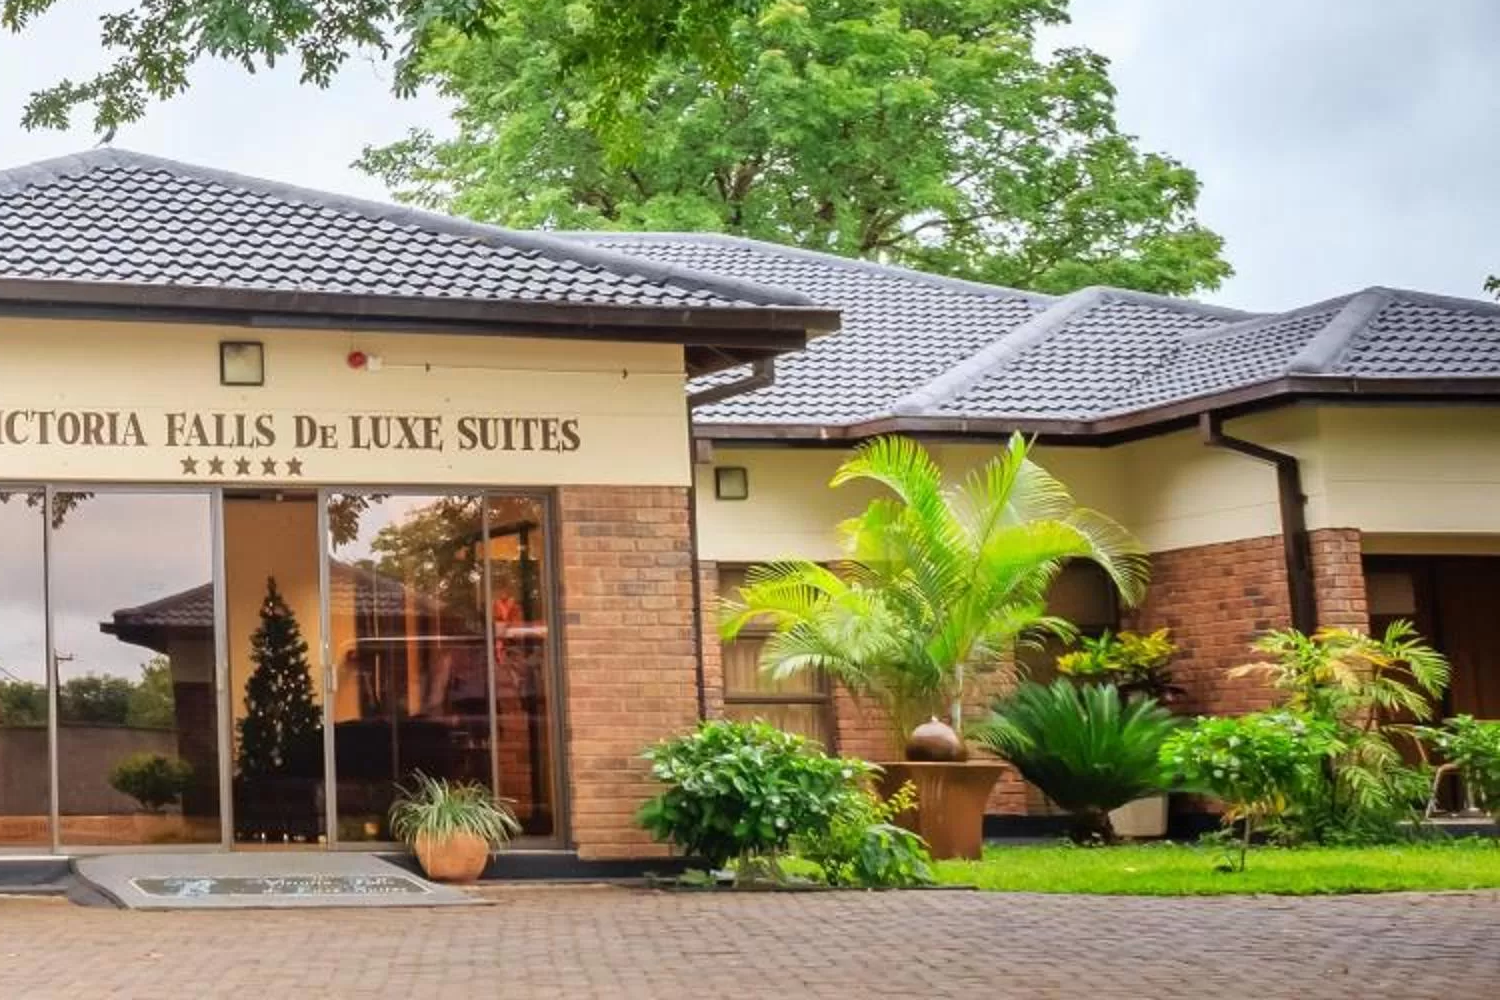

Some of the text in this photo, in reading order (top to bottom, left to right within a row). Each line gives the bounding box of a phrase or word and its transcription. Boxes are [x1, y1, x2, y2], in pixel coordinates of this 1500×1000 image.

[164, 411, 277, 449] FALLS
[348, 415, 444, 452] LUXE
[456, 416, 581, 454] SUITES
